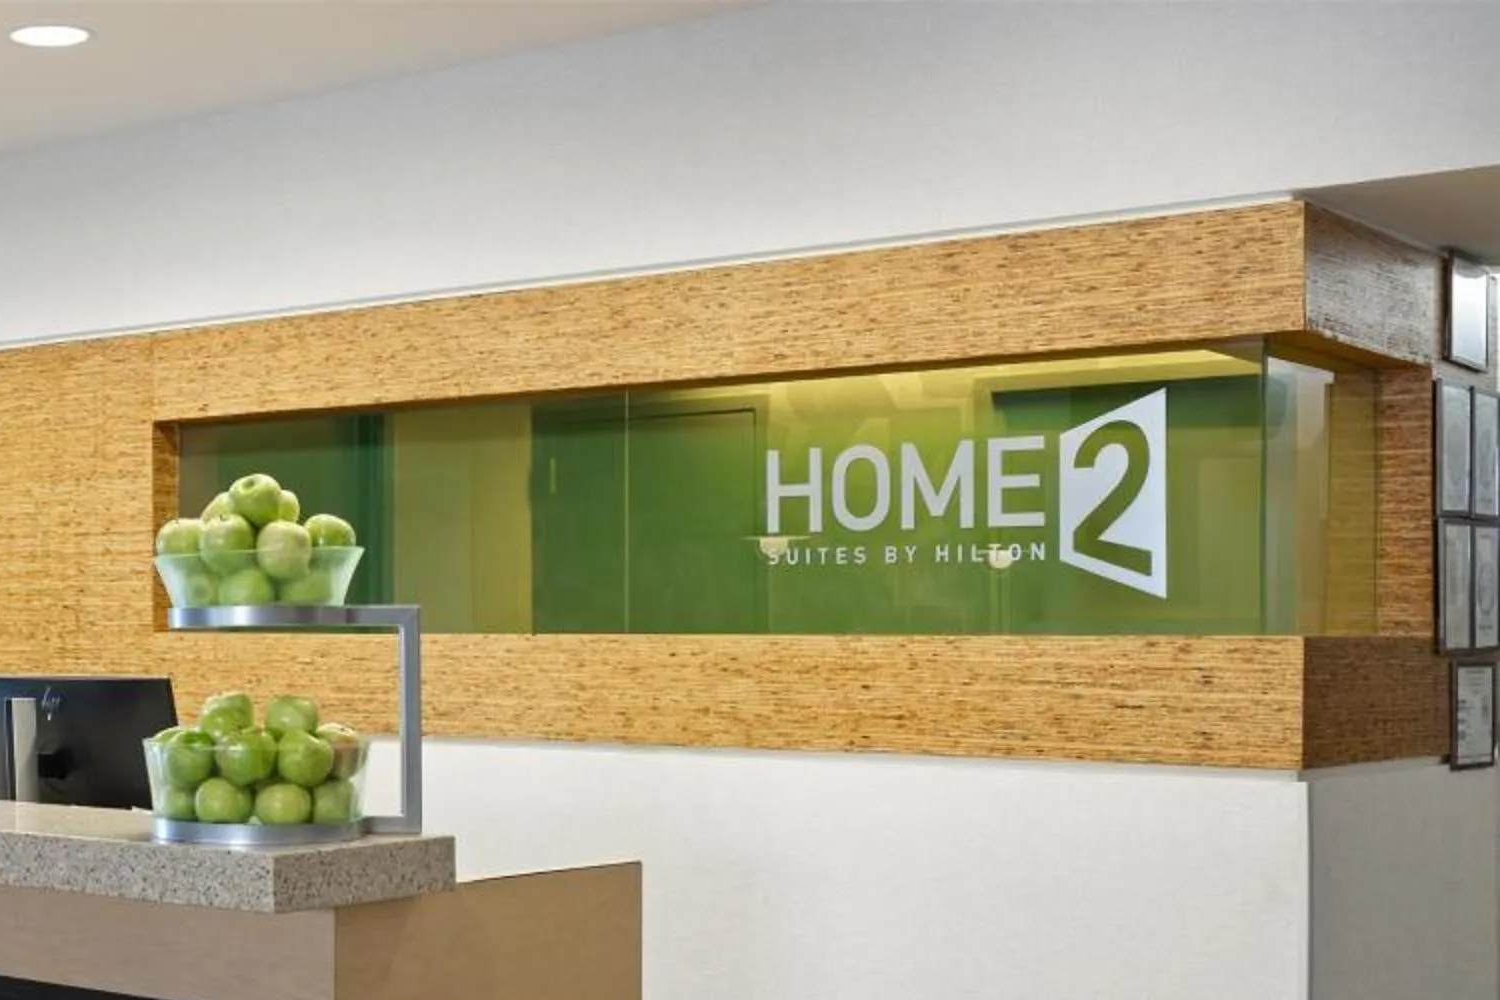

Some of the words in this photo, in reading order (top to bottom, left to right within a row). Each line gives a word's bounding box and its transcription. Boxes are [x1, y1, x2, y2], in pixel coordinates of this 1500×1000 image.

[767, 547, 867, 565] SUITES
[885, 546, 917, 563] BY
[935, 542, 1046, 563] HILTON
